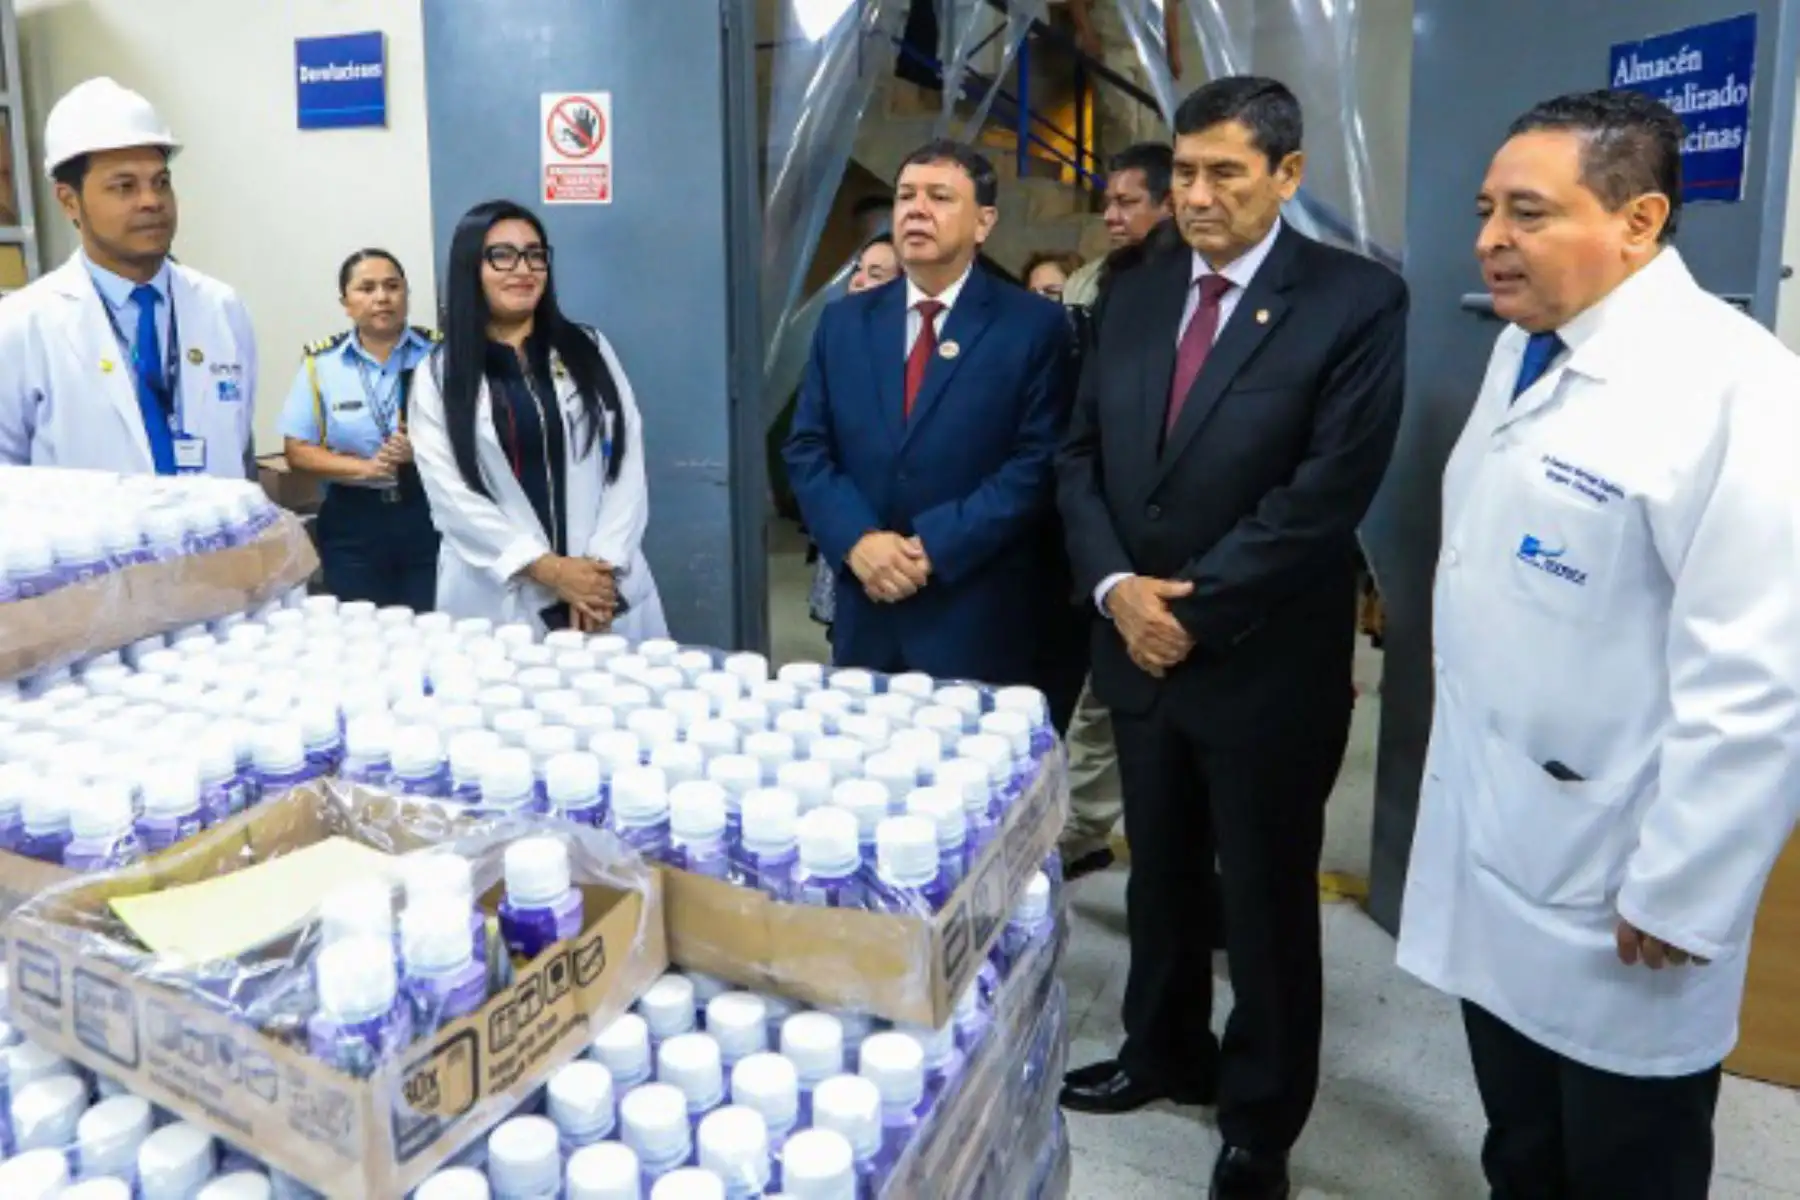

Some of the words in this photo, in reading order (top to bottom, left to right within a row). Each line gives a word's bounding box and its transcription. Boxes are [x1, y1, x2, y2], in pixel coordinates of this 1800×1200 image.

[1613, 44, 1703, 87] Almacén
[1658, 73, 1748, 114] ializado
[1678, 121, 1742, 154] cinas
